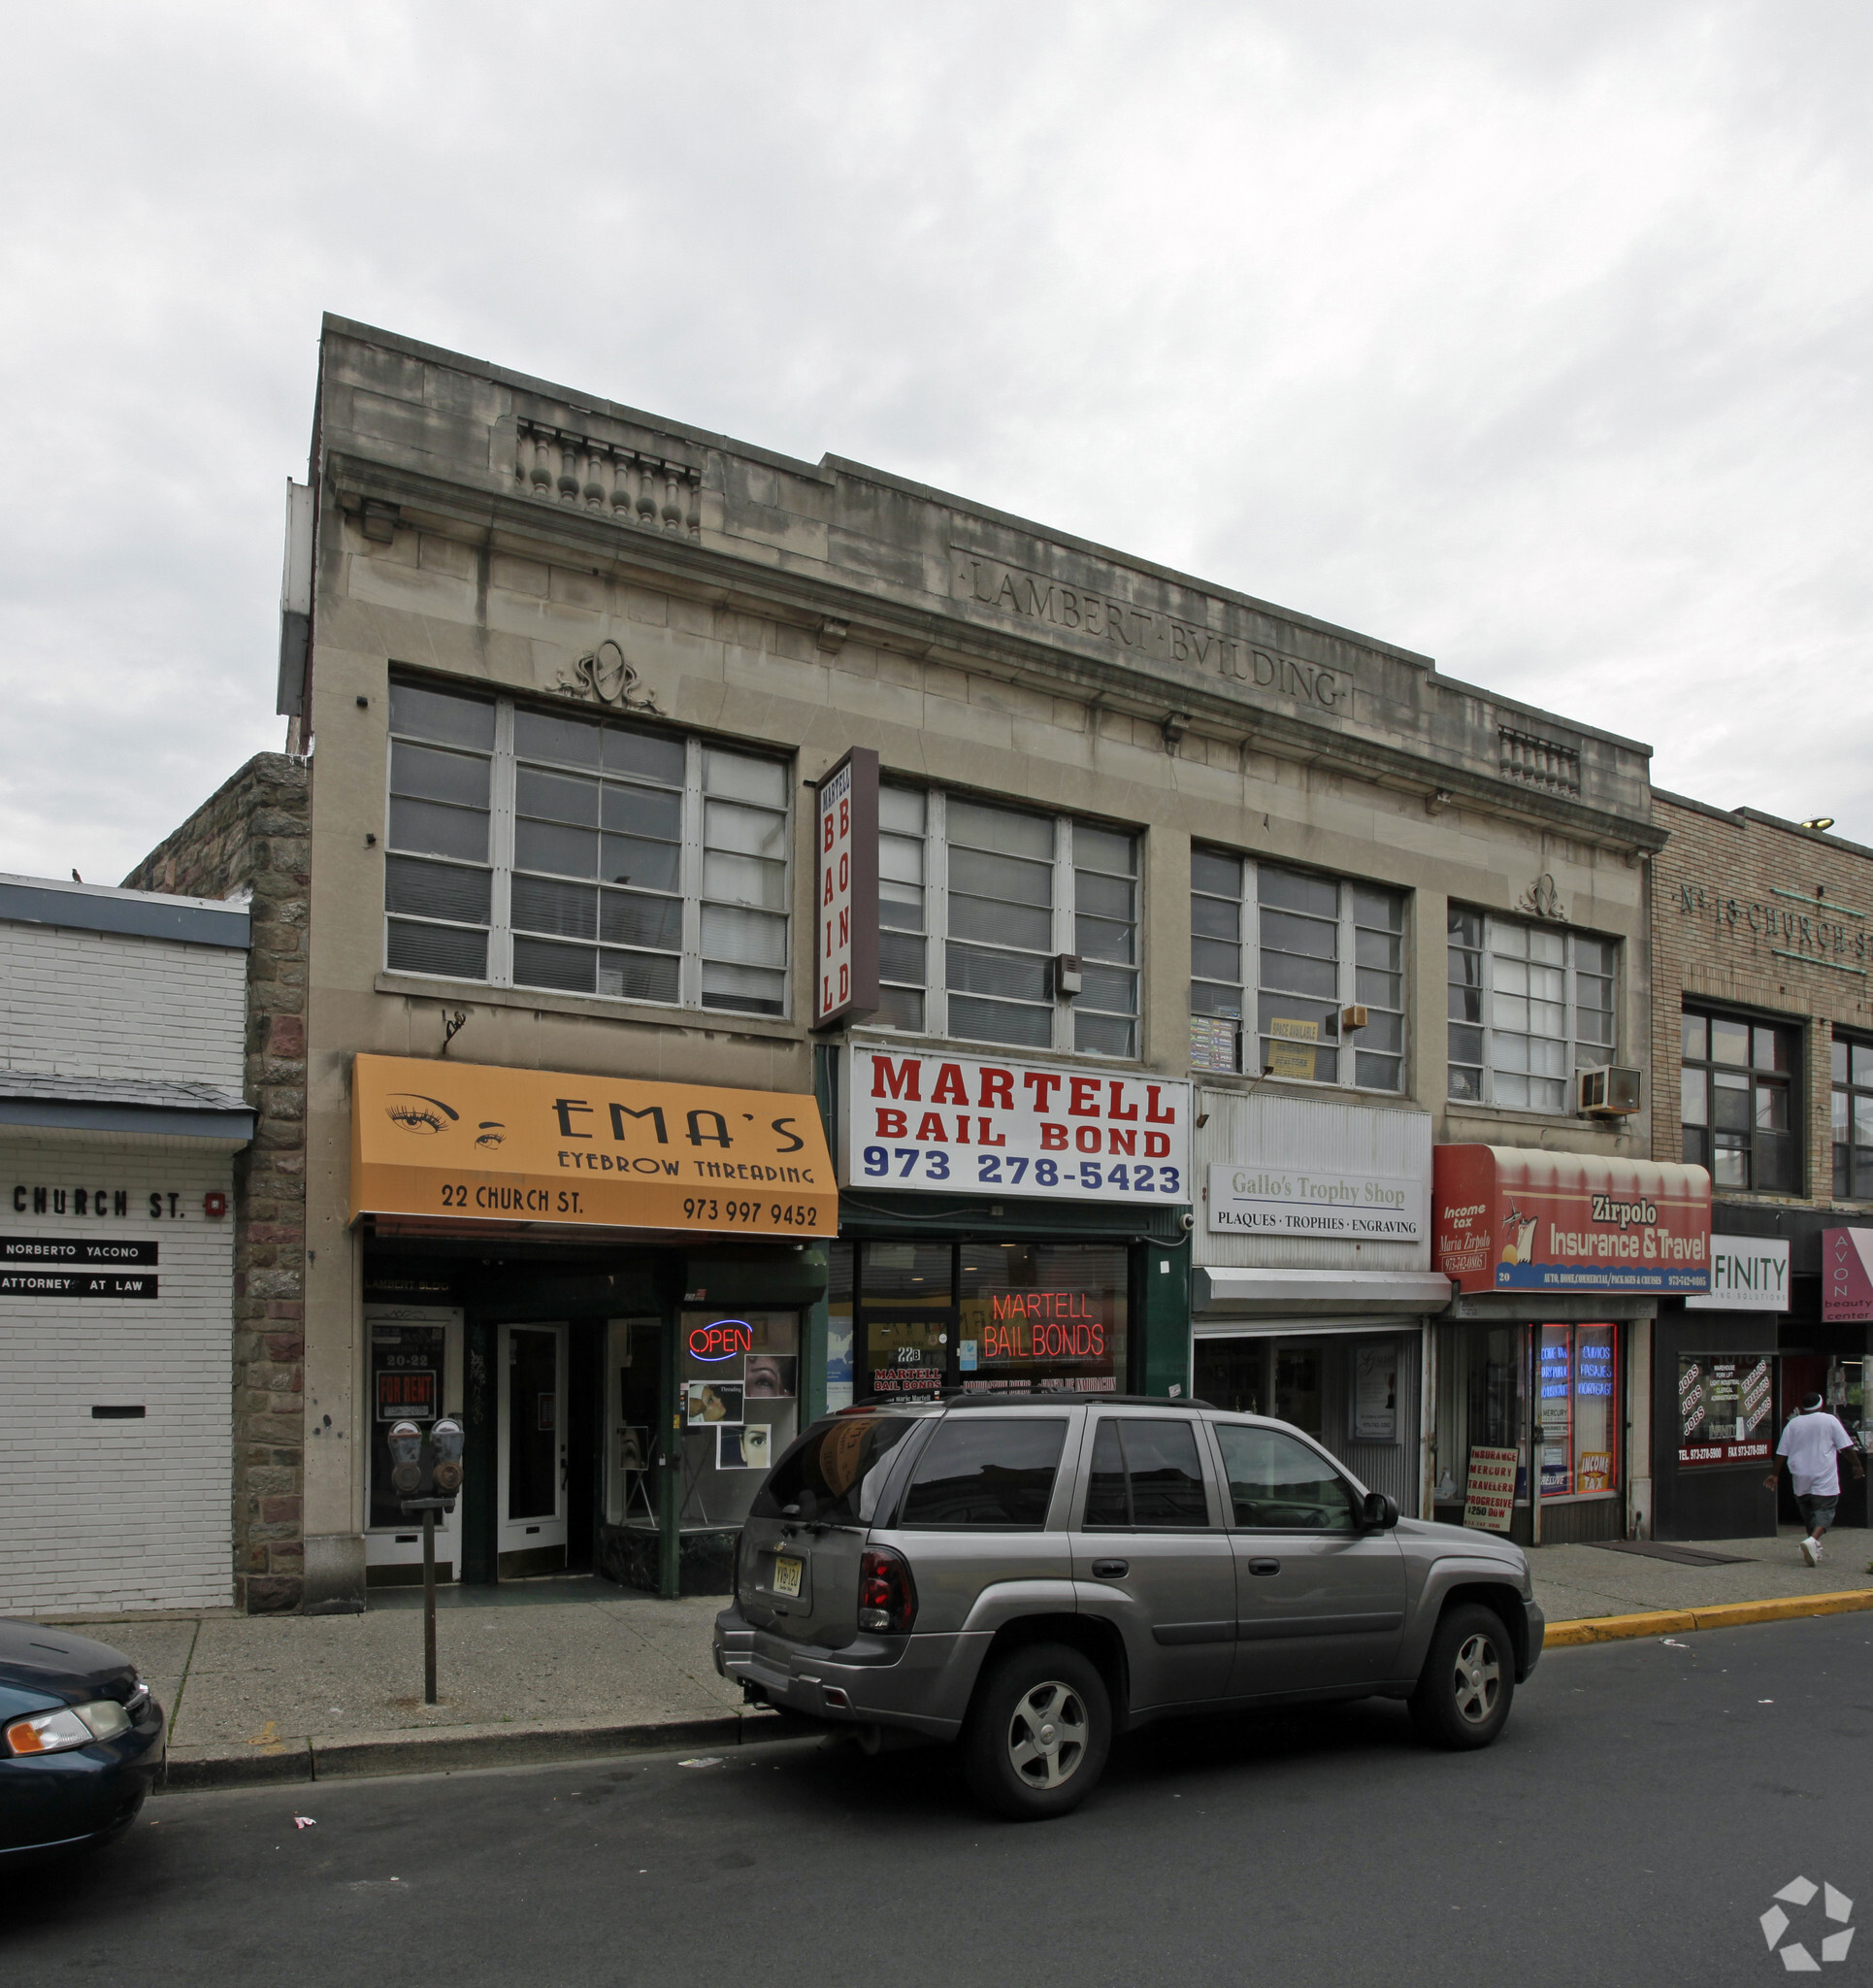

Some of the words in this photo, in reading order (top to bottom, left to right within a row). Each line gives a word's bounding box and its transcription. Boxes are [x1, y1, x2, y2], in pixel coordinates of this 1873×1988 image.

[969, 562, 1152, 650] LAMBERT
[1167, 623, 1336, 707] BVILDING
[823, 767, 850, 812] MARTELL
[1716, 897, 1738, 923] 18
[1749, 904, 1845, 952] CHURCH
[1856, 932, 1873, 959] S
[871, 1055, 1175, 1124] MARTELL
[551, 1098, 805, 1153] EMA'S
[875, 1108, 1006, 1147] BAIL
[1039, 1122, 1170, 1158] BOND
[557, 1150, 680, 1176] EYEBROW
[694, 1160, 815, 1184] THREADING
[863, 1145, 951, 1180] 973
[977, 1154, 1180, 1194] 278-5423
[14, 1185, 127, 1216] CHURCH
[149, 1193, 185, 1218] ST.
[1232, 1172, 1292, 1196] Gallo's
[1298, 1177, 1360, 1208] Trophy
[1364, 1181, 1405, 1209] Shop
[441, 1184, 468, 1207] 22
[476, 1186, 549, 1211] CHURCH
[557, 1191, 584, 1213] ST.
[683, 1198, 718, 1220] 973
[726, 1201, 762, 1223] 997
[771, 1204, 818, 1226] 9452
[1444, 1204, 1486, 1219] Income
[1593, 1195, 1657, 1230] Zirpolo
[1218, 1211, 1276, 1227] PLAQUES
[1285, 1215, 1344, 1230] TROPHIES
[1352, 1219, 1417, 1233] ENGRAVING
[1453, 1217, 1472, 1229] tax
[6, 1244, 76, 1256] NORBERTO
[86, 1246, 139, 1258] YACONO
[1439, 1235, 1462, 1252] Maria
[1463, 1230, 1491, 1251] Zirpolo
[1551, 1223, 1639, 1258] Insurance
[1658, 1229, 1705, 1260] Travel
[1498, 1273, 1510, 1281] 20
[1641, 1276, 1662, 1285] CRUISES
[1711, 1255, 1787, 1291] FINITY
[1834, 1236, 1849, 1297] AVON
[2, 1277, 71, 1290] ATTORNEY
[90, 1280, 106, 1290] AT
[115, 1281, 143, 1292] LAW
[1737, 1292, 1787, 1302] SOLUTIONS
[993, 1293, 1092, 1320] MARTELL
[1824, 1299, 1872, 1309] beauty
[1826, 1311, 1870, 1320] center
[689, 1329, 751, 1352] OPEN
[984, 1326, 1029, 1357] BAIL
[1033, 1323, 1104, 1356] BONDS
[387, 1354, 428, 1366] 20-22
[874, 1368, 941, 1380] MARTELL
[380, 1375, 401, 1404] FOR
[403, 1375, 432, 1404] RENT
[874, 1380, 901, 1391] BAIL
[903, 1380, 941, 1390] BONDS
[1679, 1364, 1699, 1395] JOBS
[1741, 1359, 1766, 1394] TRABAJOS
[1682, 1384, 1702, 1415] JOBS
[1744, 1375, 1770, 1410] TRABAJOS
[1684, 1406, 1705, 1436] JOBS
[1747, 1396, 1771, 1432] TRABAJOS
[1582, 1456, 1609, 1474] INCOME
[1679, 1449, 1690, 1460] TEL.
[1728, 1446, 1737, 1457] FAX
[1470, 1465, 1512, 1476] MERCURY
[1584, 1476, 1602, 1490] TAX
[1468, 1479, 1513, 1492] TRAVELERS
[1466, 1495, 1513, 1508] PROGRESIVE
[1467, 1506, 1487, 1515] $250
